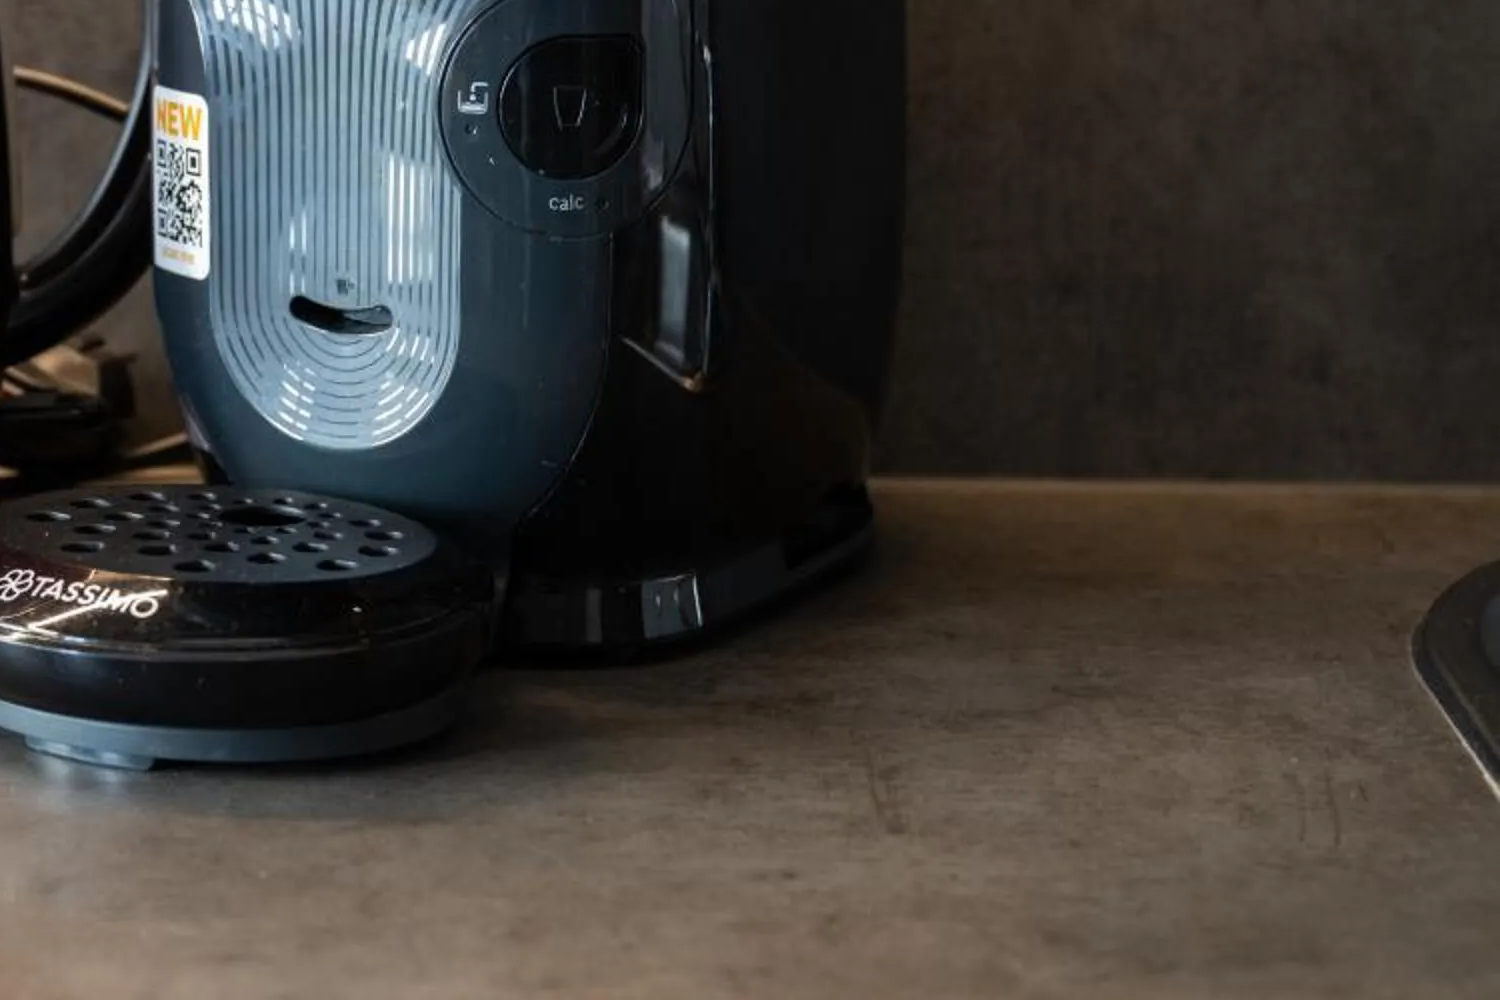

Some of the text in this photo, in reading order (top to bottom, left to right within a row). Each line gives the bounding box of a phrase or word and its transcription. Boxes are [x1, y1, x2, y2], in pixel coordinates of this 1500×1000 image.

[156, 98, 203, 141] NEW
[549, 193, 584, 211] calc
[31, 576, 159, 619] TASSIMO
